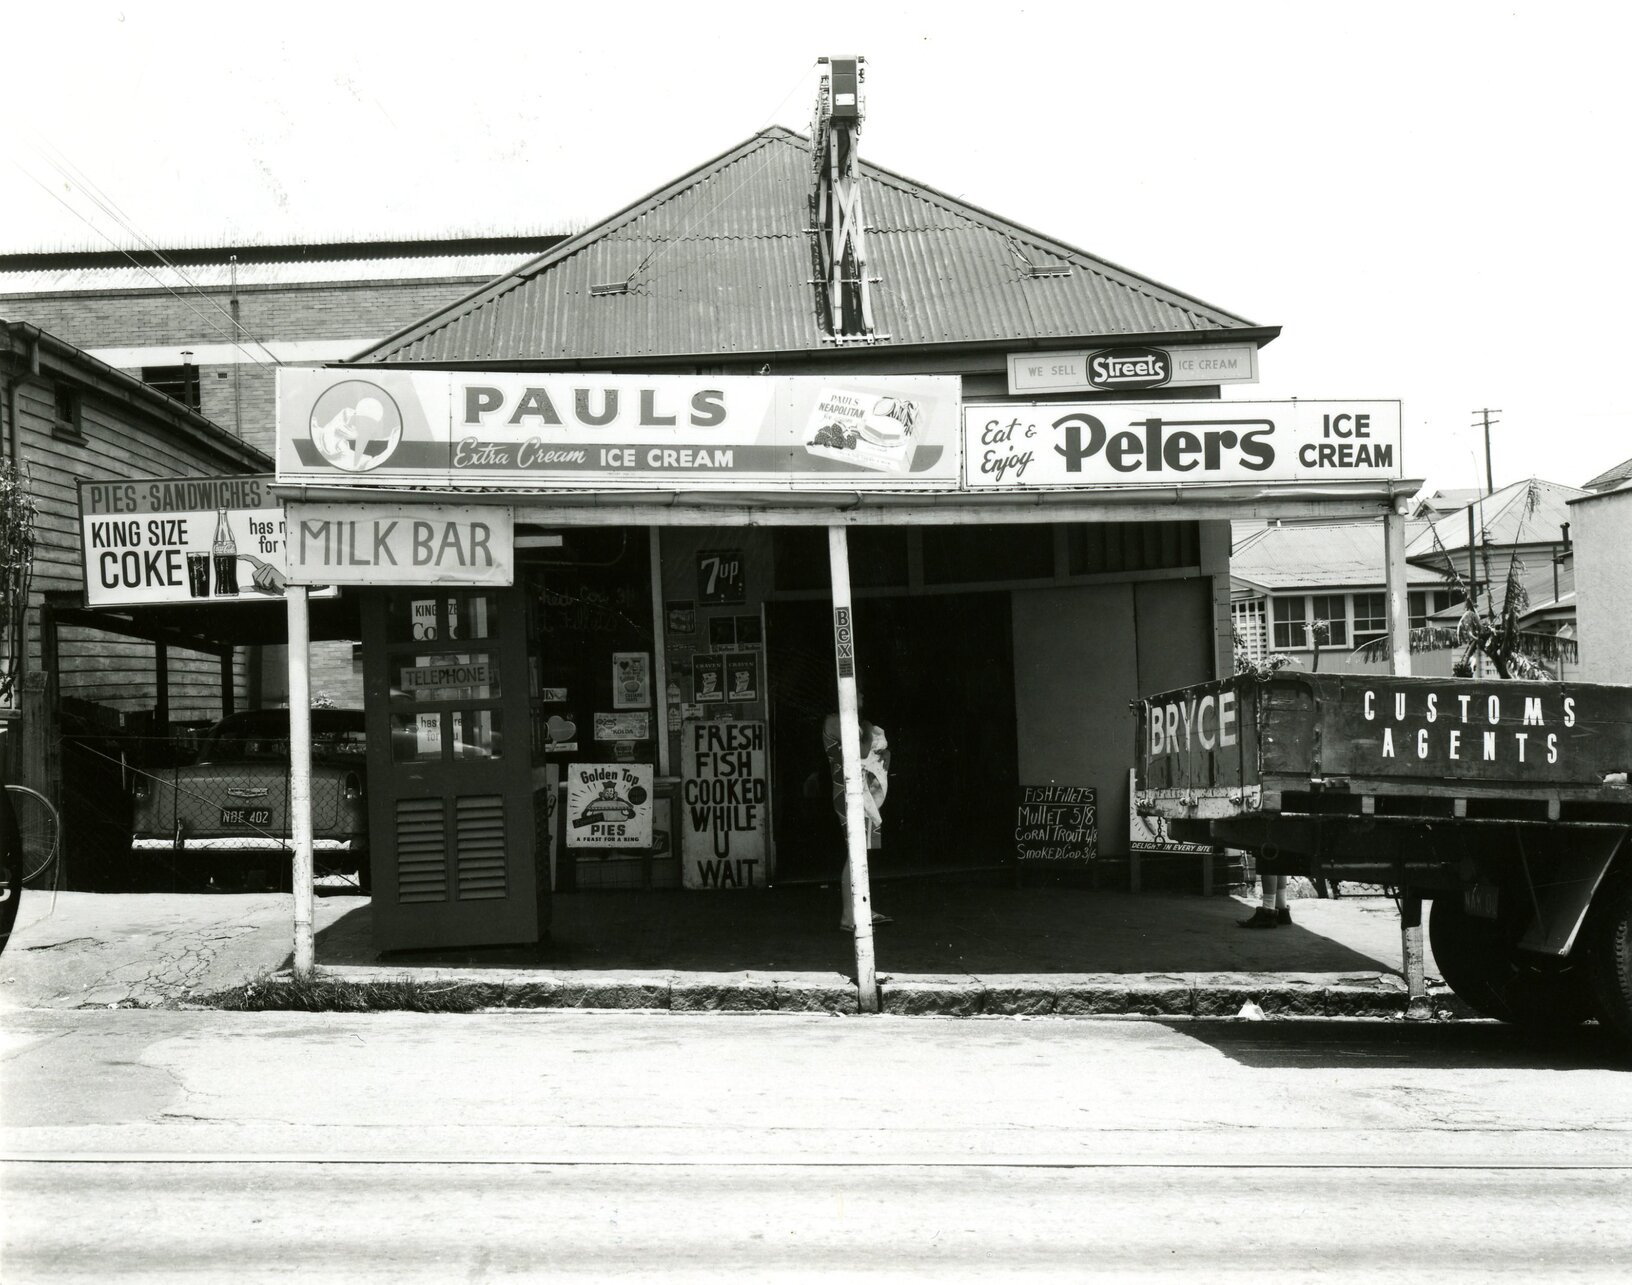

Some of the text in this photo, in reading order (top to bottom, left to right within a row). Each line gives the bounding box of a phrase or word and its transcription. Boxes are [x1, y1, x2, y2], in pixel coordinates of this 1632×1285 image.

[1028, 365, 1077, 377] WE SELL
[1092, 354, 1165, 383] Streets
[1179, 359, 1238, 370] ICE CREAM
[464, 386, 727, 427] PAULS
[819, 402, 866, 418] NEAPOLITAN
[981, 418, 1037, 446] Eat &
[1323, 413, 1370, 438] ICE
[453, 436, 734, 468] Extra Cream ICE CREAM
[1051, 413, 1275, 472] Peters
[1299, 443, 1393, 468] CREAM
[980, 445, 1035, 481] Enjoy
[90, 480, 262, 514] PIES SANDWICHES
[91, 519, 189, 548] KING SIZE
[249, 517, 274, 535] has
[258, 535, 278, 554] for
[300, 520, 493, 567] MILK BAR
[100, 549, 183, 589] COKE
[835, 609, 852, 658] Bex
[405, 666, 486, 686] TELEPHONE
[420, 716, 437, 728] has
[1363, 690, 1577, 728] CUSTOMS
[1150, 691, 1237, 755] BRYCE
[694, 724, 763, 751] FRESH
[1382, 727, 1558, 764] AGENTS
[580, 768, 640, 786] Golden Top
[696, 751, 752, 778] FISH
[685, 778, 765, 806] COOKED
[250, 811, 269, 823] 402
[691, 805, 757, 832] WHILE
[1069, 805, 1096, 827] 5/8
[591, 824, 626, 836] PIES
[713, 830, 730, 858] U
[1196, 845, 1212, 853] BITE
[697, 859, 759, 888] WAIT
